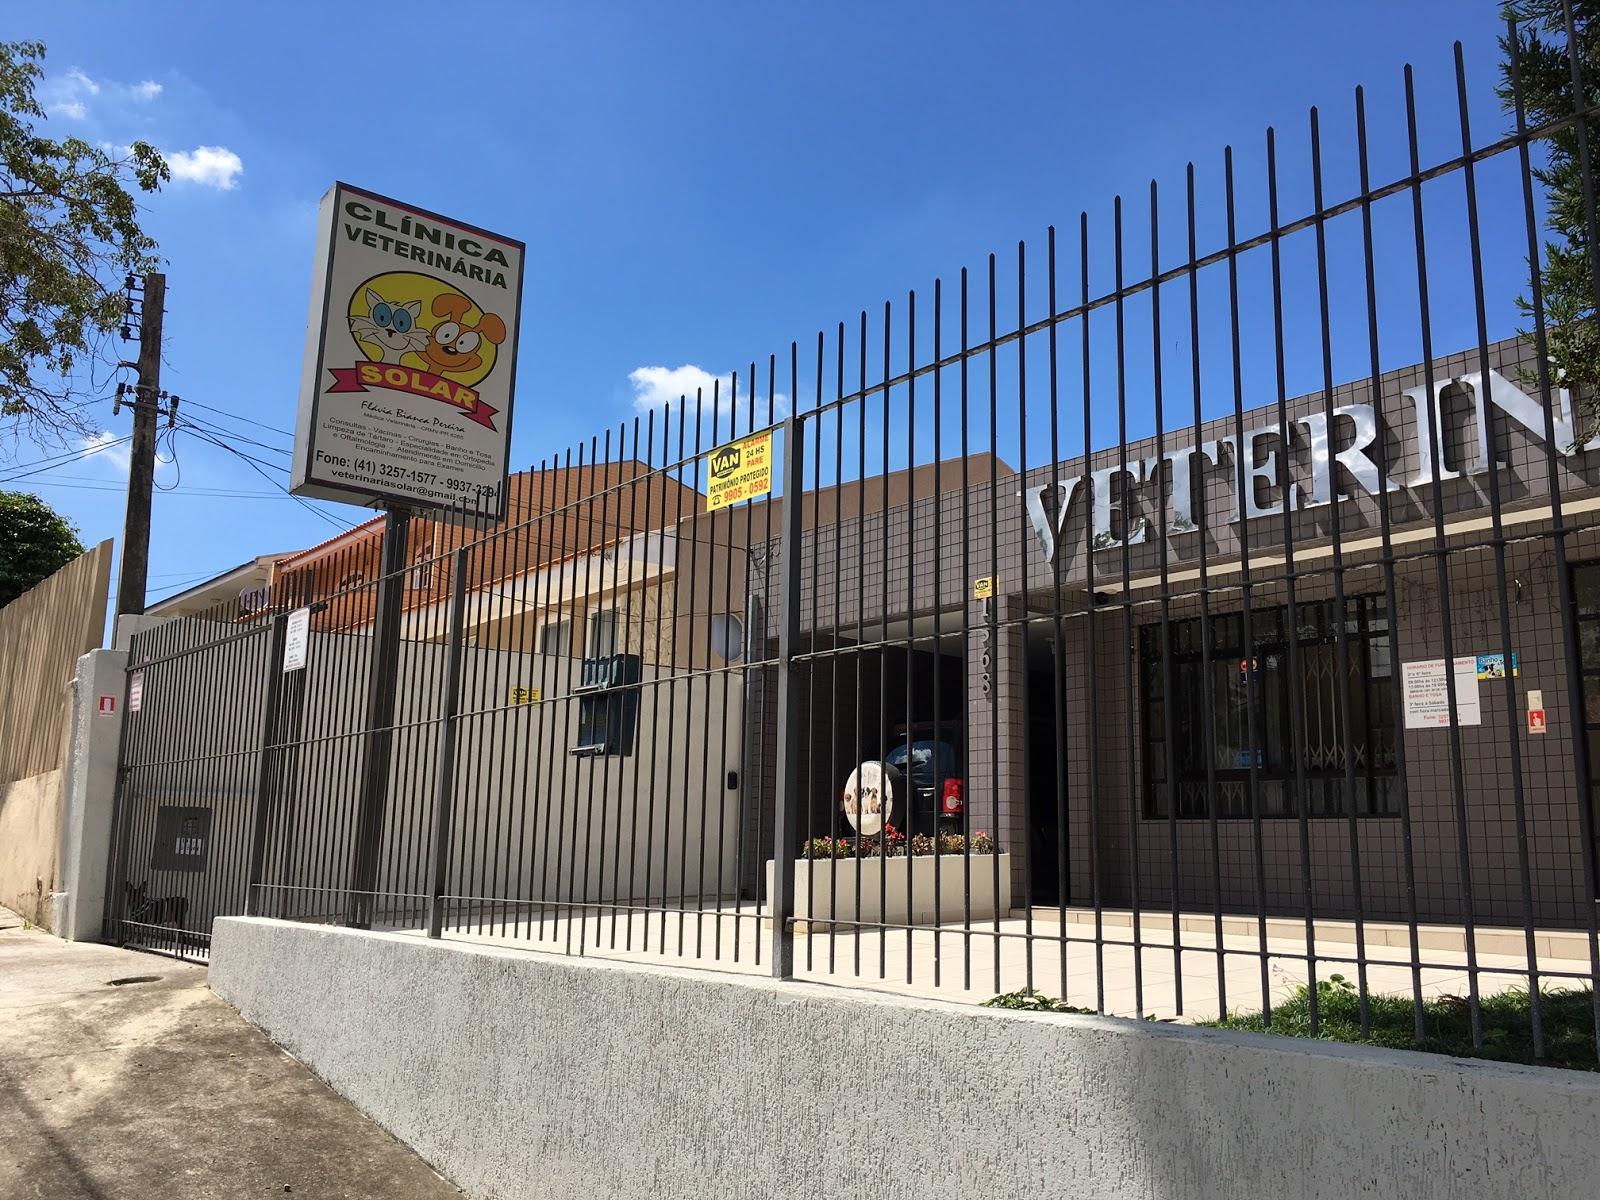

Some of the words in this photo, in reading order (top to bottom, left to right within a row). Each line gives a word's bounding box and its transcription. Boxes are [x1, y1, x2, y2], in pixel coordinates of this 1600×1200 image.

[345, 202, 510, 268] CLÍNICA
[344, 223, 508, 290] VETERINÁRIA
[360, 365, 477, 409] SOLAR
[361, 400, 393, 415] Flávia
[396, 408, 430, 424] Bianca
[433, 417, 465, 433] Pereira
[322, 422, 355, 435] Limpeza
[400, 439, 449, 456] Especialidade
[462, 454, 495, 467] Ortopedia
[329, 416, 367, 430] Consultas
[373, 427, 402, 438] Vacinas
[408, 435, 440, 448] Cirurgias
[446, 443, 468, 454] Banho
[476, 450, 492, 460] Tosa
[340, 433, 386, 449] Oftalmologia
[397, 446, 441, 461] Atendimento
[442, 456, 454, 464] em
[746, 449, 754, 459] 24
[755, 445, 765, 454] HS
[316, 449, 350, 468] Fone:
[354, 457, 376, 476] (41)
[379, 463, 437, 485] 3257-1577
[355, 443, 418, 462] Encaminhamento
[419, 458, 435, 467] para
[436, 461, 465, 473] Exames
[712, 452, 739, 473] VAN
[746, 456, 764, 468] PARE
[1016, 366, 1600, 563] VETERIN
[724, 486, 743, 502] 9905
[749, 478, 768, 494] 0592
[740, 467, 769, 484] PROTEGIDO
